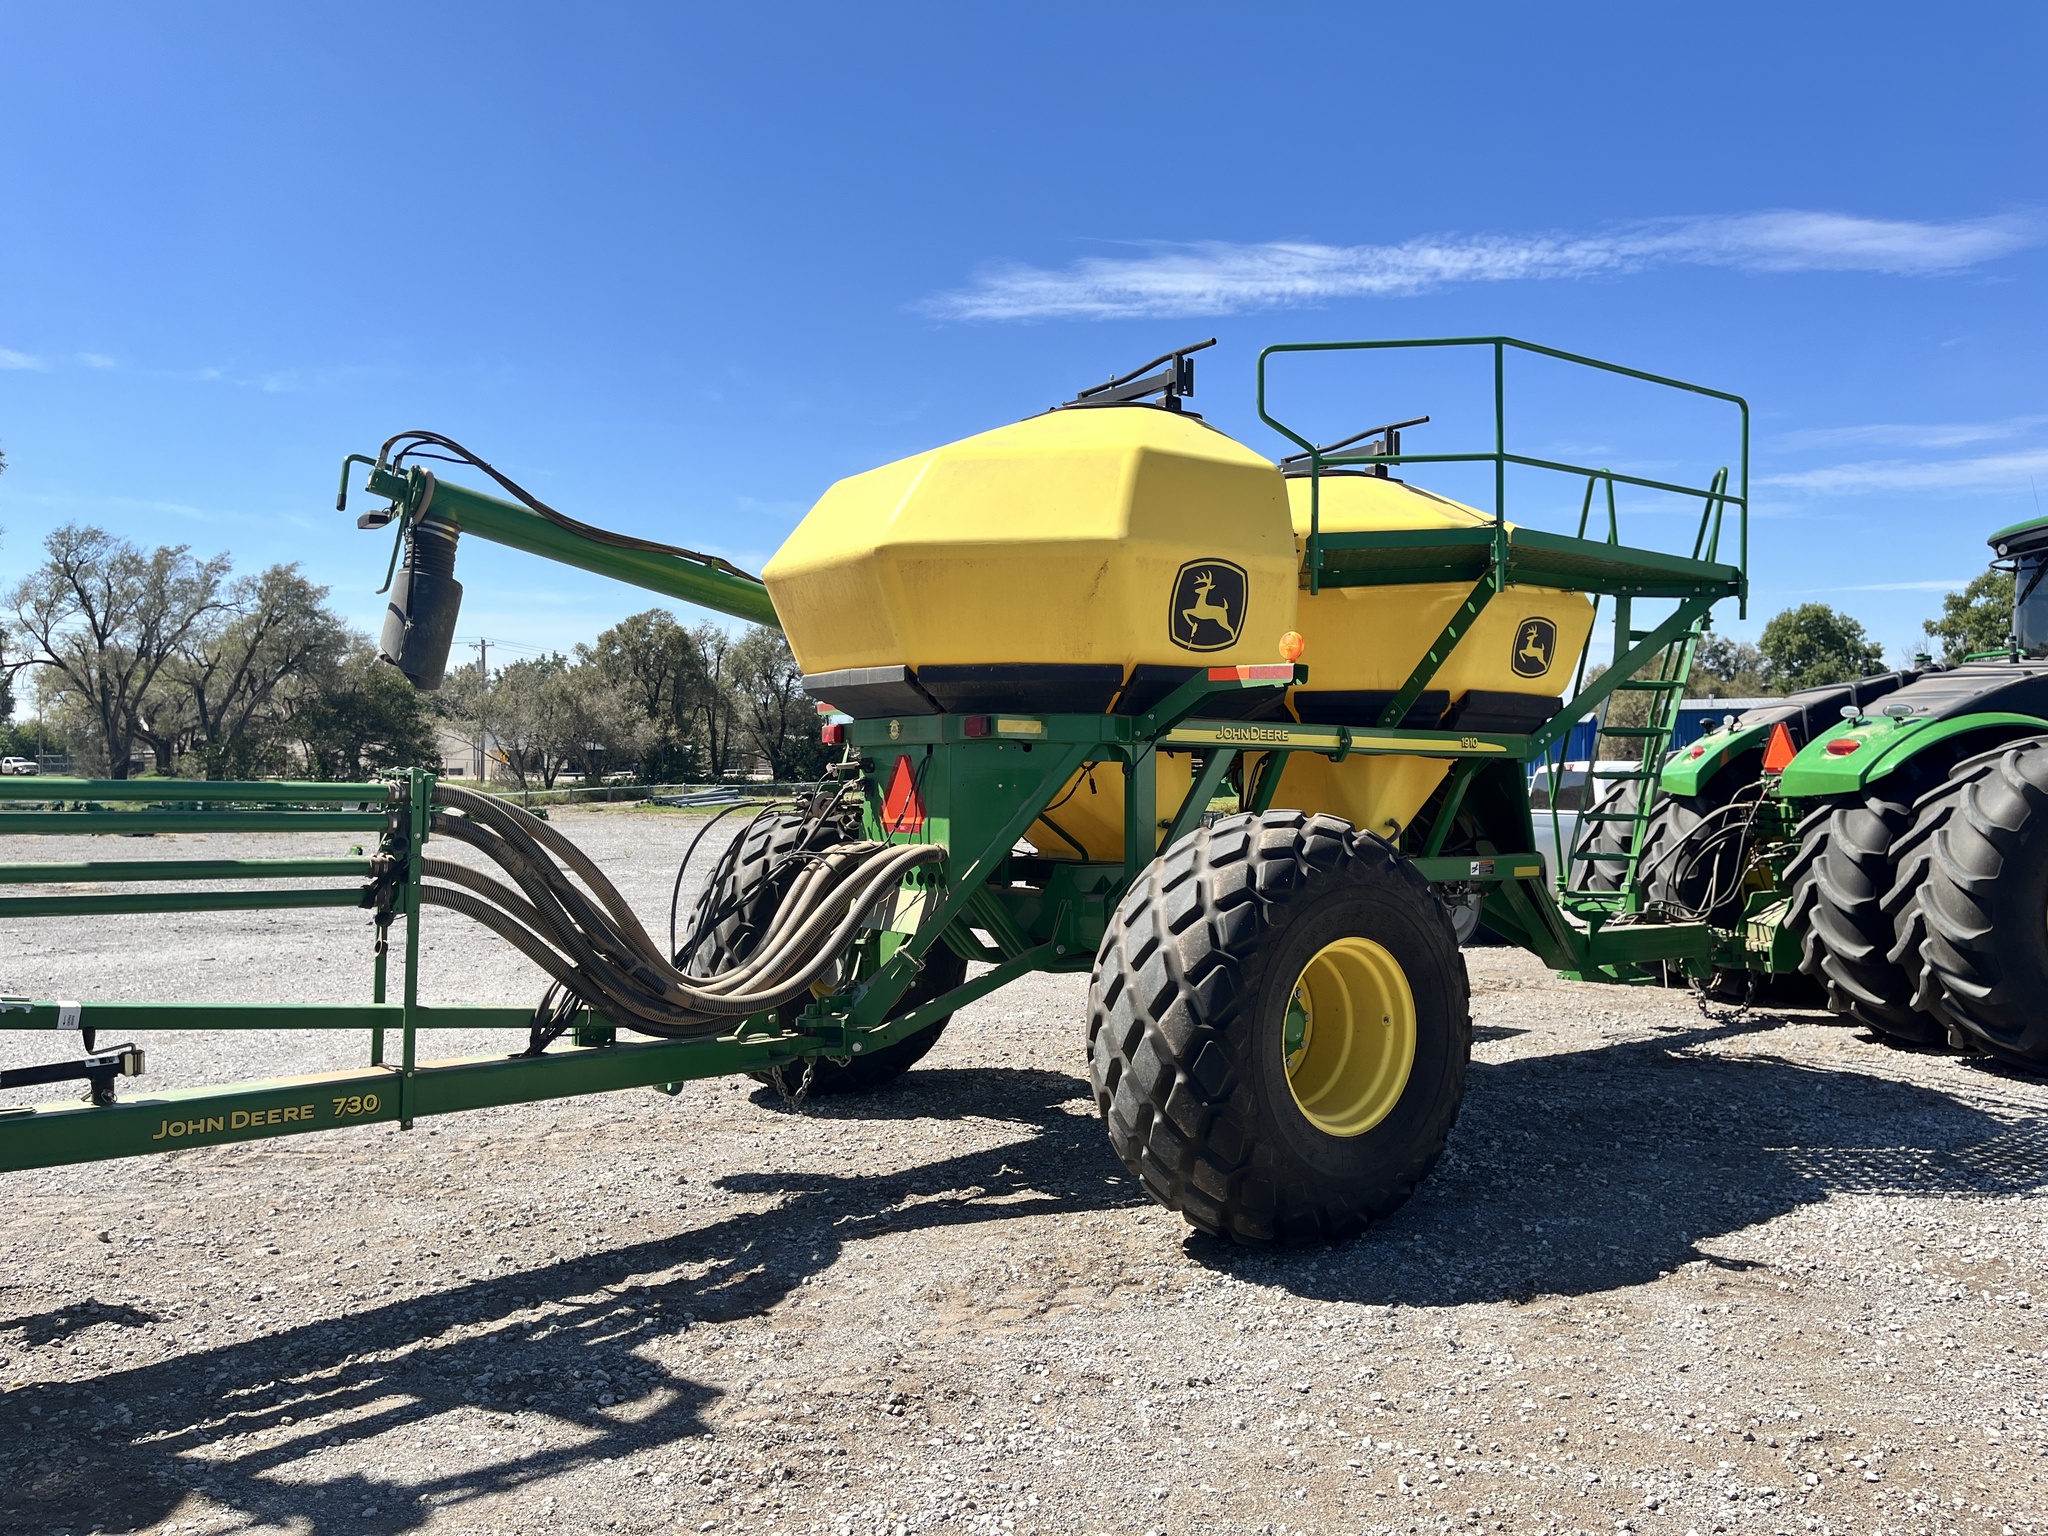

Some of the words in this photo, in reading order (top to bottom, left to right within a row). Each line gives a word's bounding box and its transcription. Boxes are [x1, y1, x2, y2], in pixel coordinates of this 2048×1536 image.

[1216, 725, 1249, 740] JOHN
[1250, 726, 1289, 742] DEERE
[1461, 737, 1478, 748] 1910
[152, 1116, 224, 1140] JOHN
[231, 1104, 315, 1130] DEERE
[332, 1094, 382, 1118] 730
